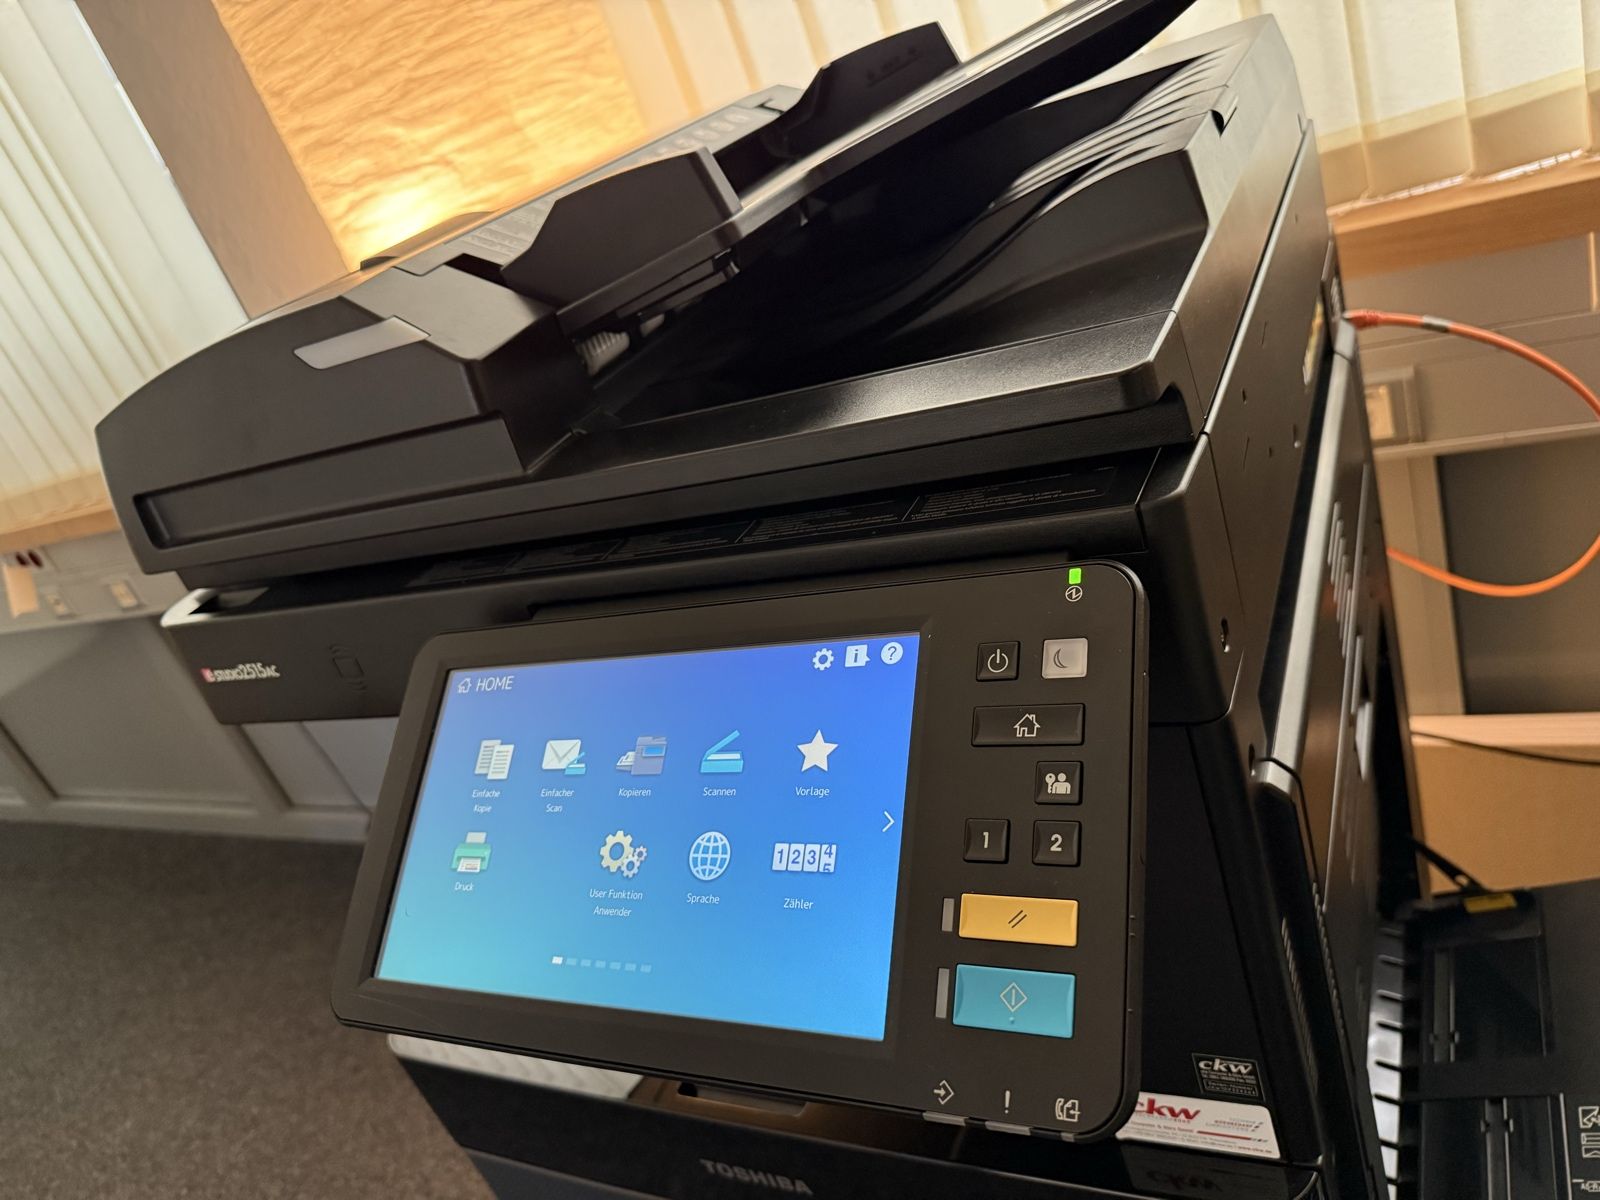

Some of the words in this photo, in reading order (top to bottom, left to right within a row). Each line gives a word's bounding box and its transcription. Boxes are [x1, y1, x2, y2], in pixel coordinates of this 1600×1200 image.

[475, 676, 514, 692] HOME
[471, 788, 501, 799] Einfache
[540, 788, 575, 798] Einfacher
[618, 787, 652, 798] Kopieren
[702, 786, 737, 797] Scannen
[795, 786, 830, 798] Vorlage
[473, 804, 492, 814] Kopie
[545, 803, 563, 813] Scan
[1050, 834, 1063, 851] 2
[454, 881, 474, 892] Druck
[589, 888, 607, 899] User
[608, 888, 643, 901] Funktion
[686, 892, 720, 905] Sprache
[783, 897, 814, 910] Zähler
[593, 905, 632, 917] Anwender
[1198, 1058, 1252, 1074] ckw
[700, 1158, 813, 1196] TOSHIBA
